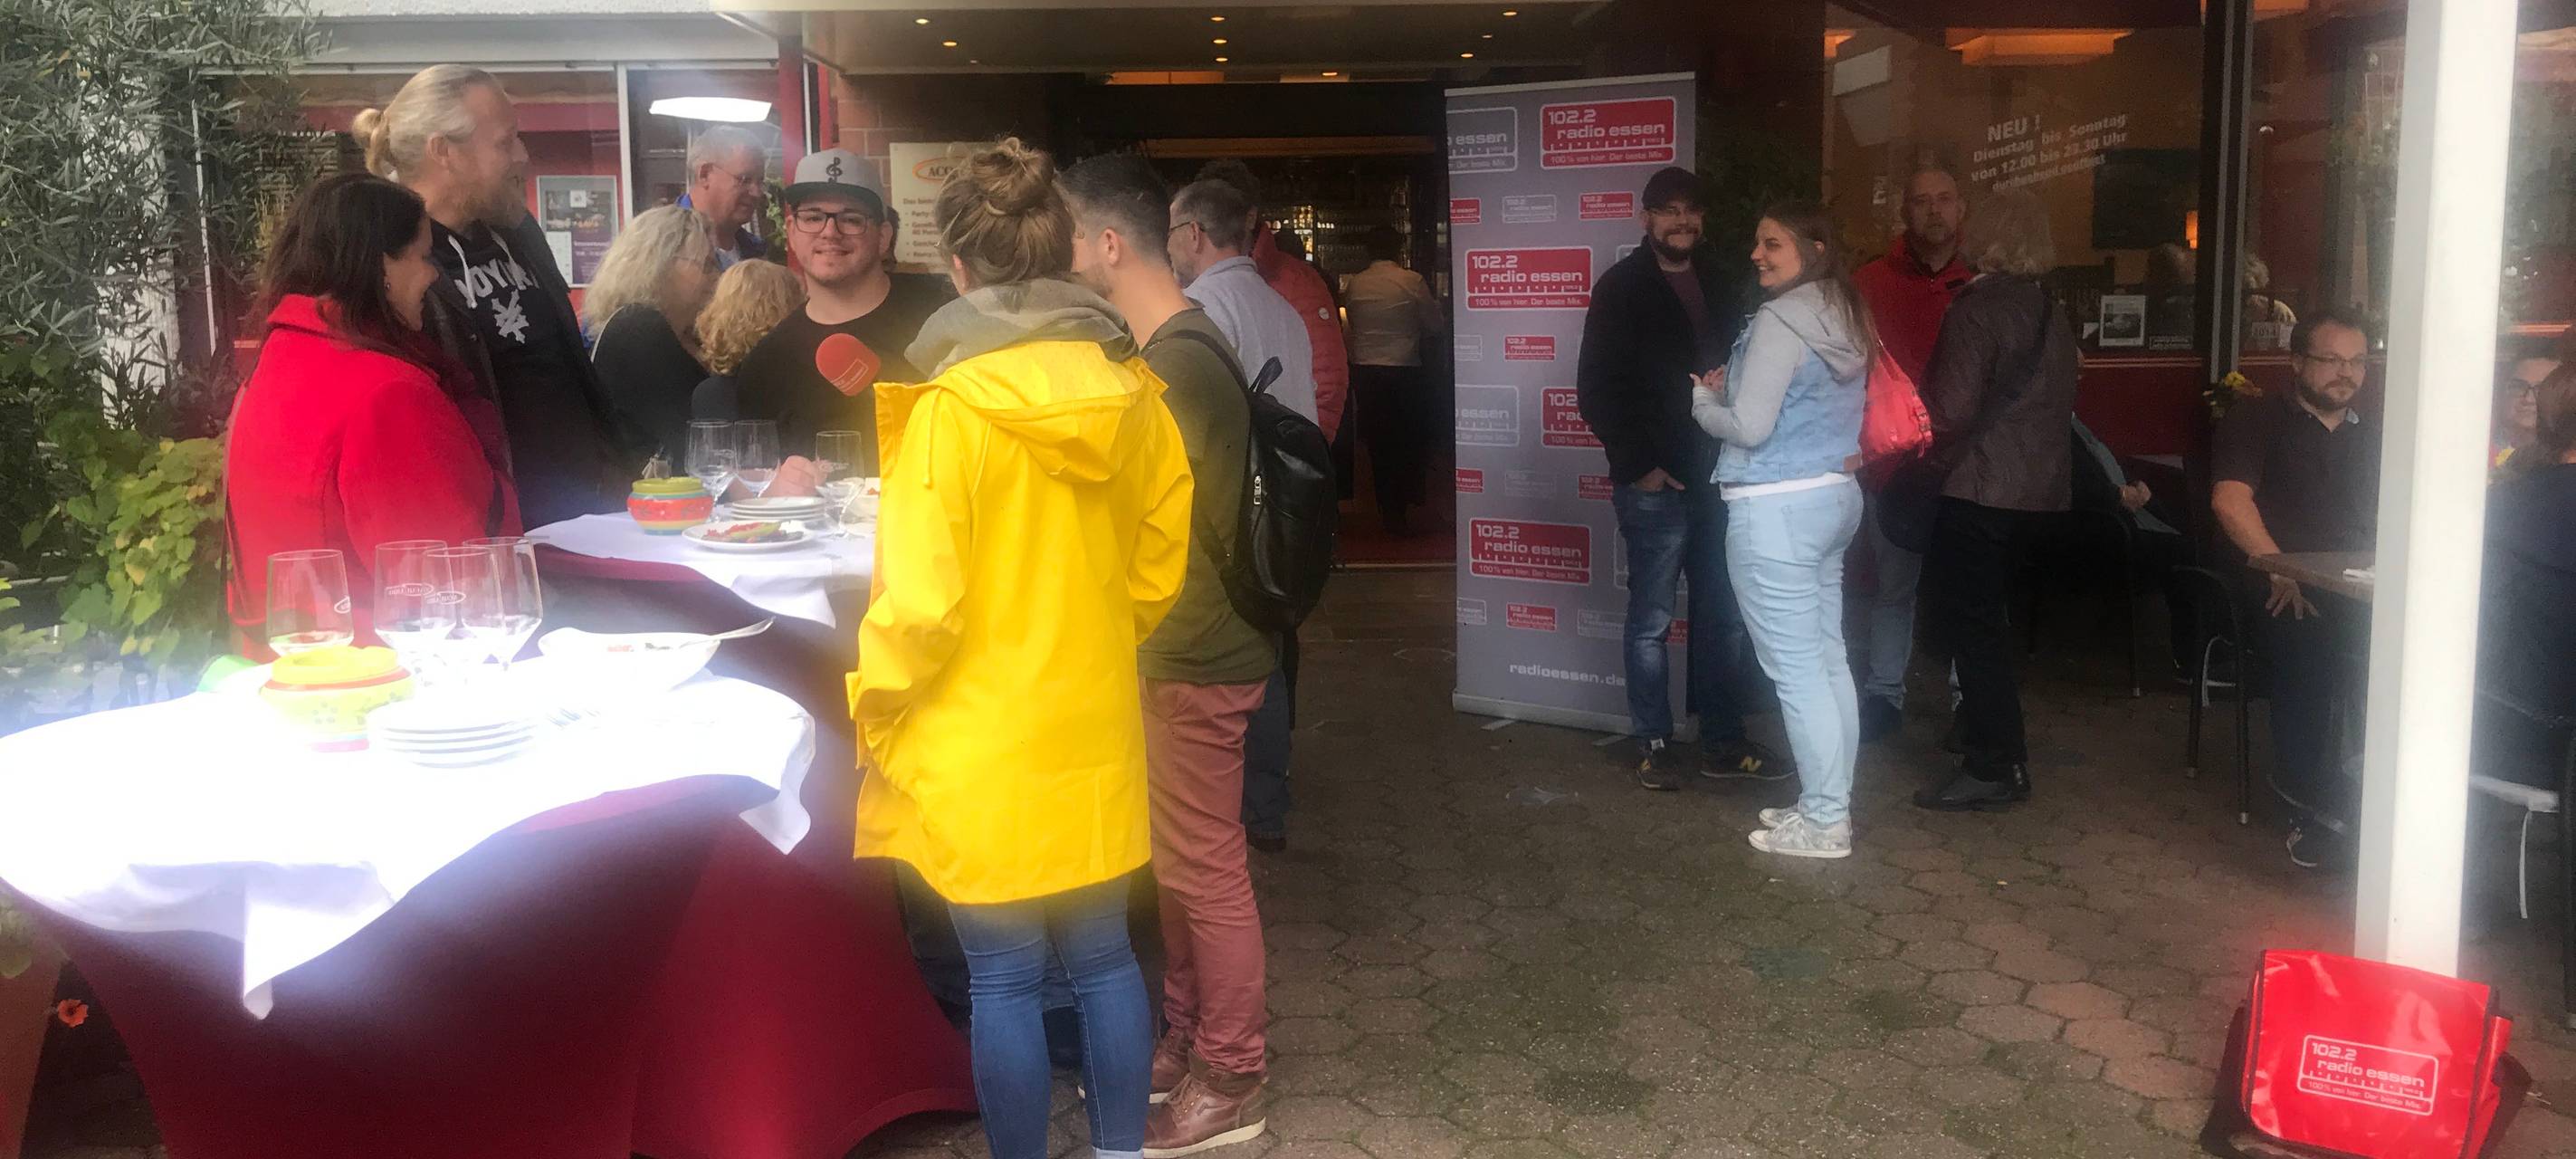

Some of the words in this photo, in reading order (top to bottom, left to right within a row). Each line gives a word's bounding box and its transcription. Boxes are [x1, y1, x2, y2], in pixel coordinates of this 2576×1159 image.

[1549, 109, 1597, 125] 102.2
[1557, 125, 1605, 139] radio
[1608, 123, 1665, 137] essen
[1987, 117, 2027, 142] NEU
[1455, 133, 1507, 145] essen
[1973, 139, 2034, 163] Dienstag
[2042, 130, 2062, 145] bis
[2069, 114, 2126, 137] Sonntag
[1970, 167, 1998, 182] von
[2001, 154, 2036, 173] 12.00
[2040, 150, 2060, 163] bis
[2103, 131, 2127, 147] Uhr
[1472, 255, 1518, 269] 102.2
[1481, 270, 1527, 283] radio
[1531, 272, 1583, 282] essen
[1549, 393, 1579, 407] 102
[1461, 408, 1510, 419] essen
[1475, 524, 1520, 540] 102.2
[1484, 541, 1528, 553] radio
[1531, 545, 1582, 558] essen
[1509, 663, 1627, 686] radioessen.de
[2312, 1042, 2357, 1061] 102.2
[2317, 1059, 2363, 1076] radio
[2366, 1068, 2425, 1087] essen
